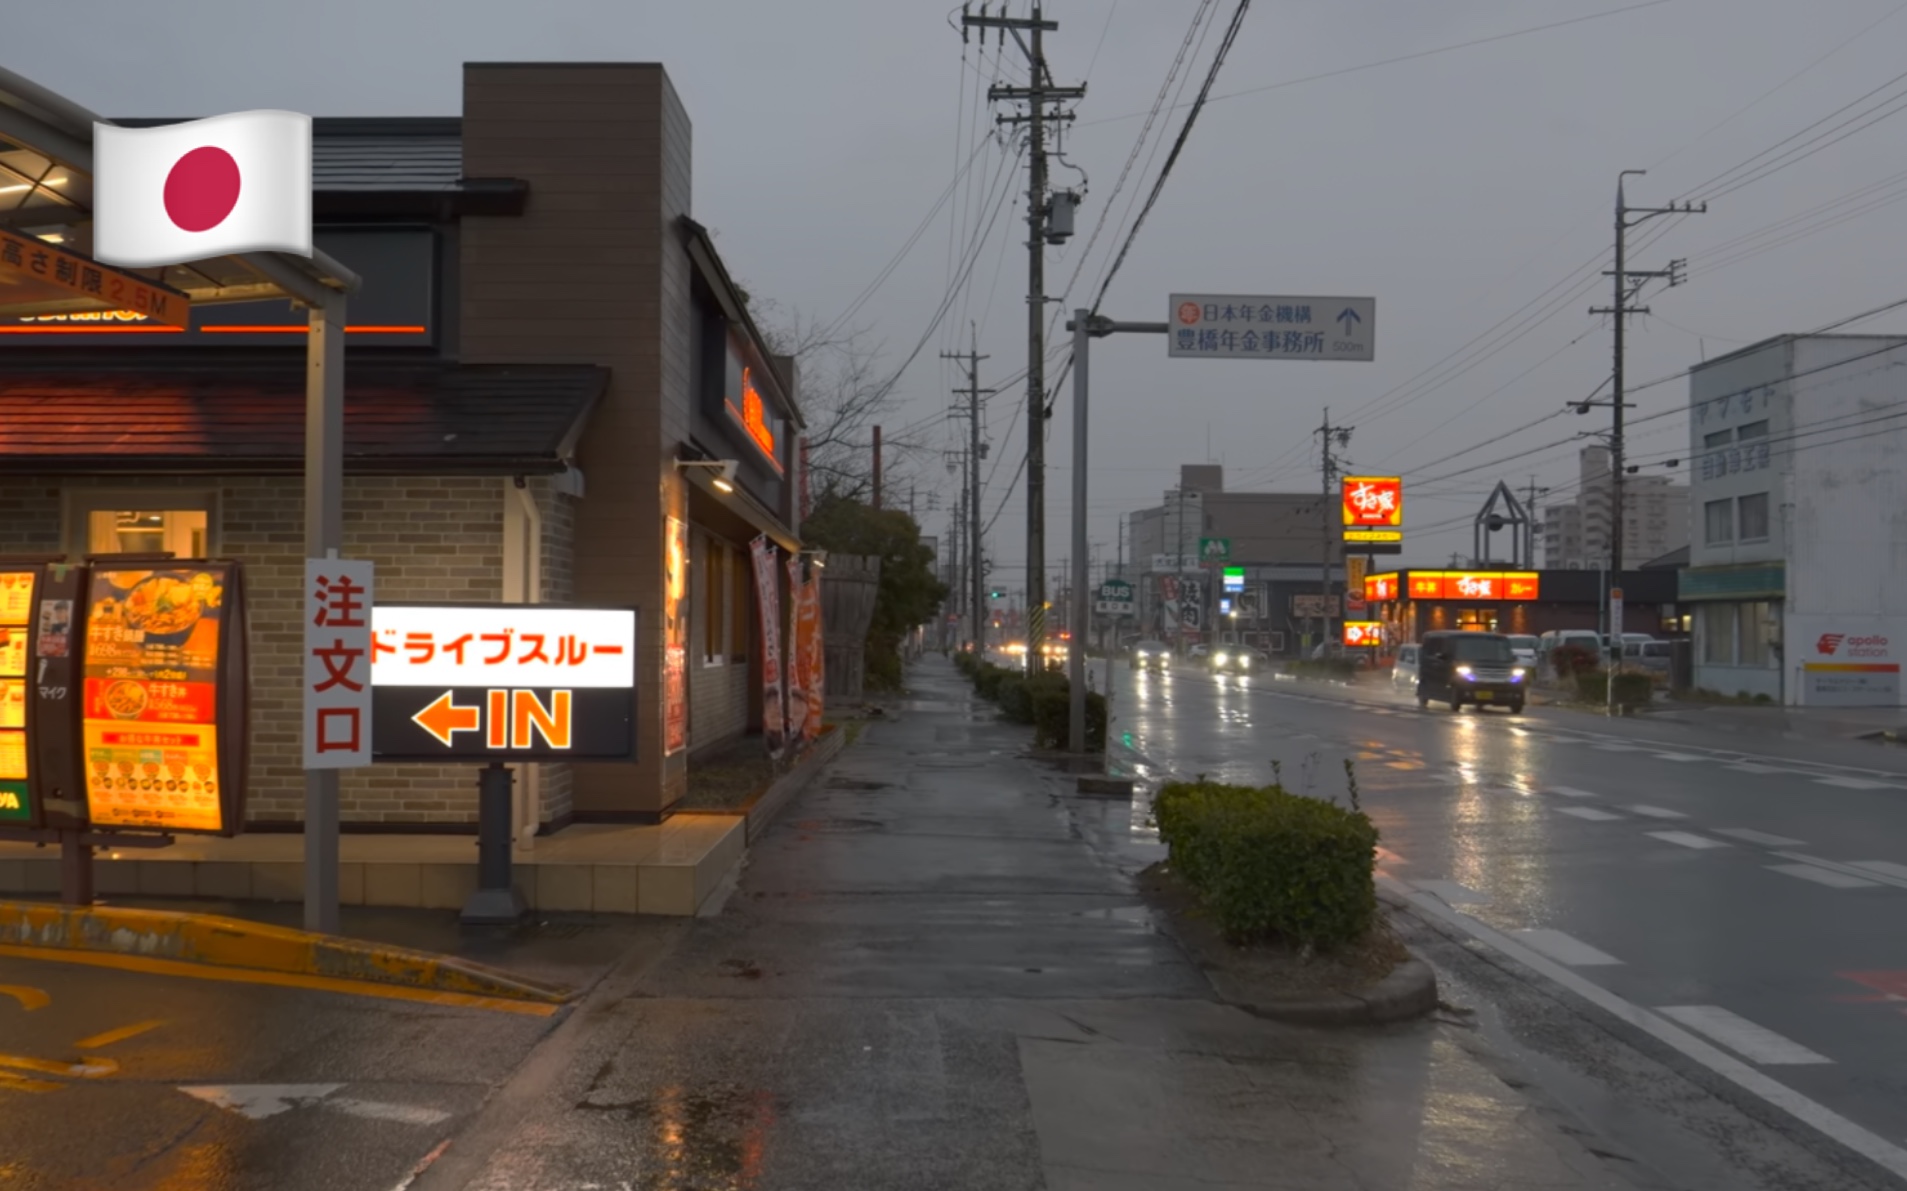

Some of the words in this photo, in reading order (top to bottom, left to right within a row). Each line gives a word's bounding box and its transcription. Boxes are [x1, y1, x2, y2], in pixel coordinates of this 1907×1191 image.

[1203, 304, 1312, 324] 日本年金機構
[1176, 329, 1325, 353] 豊橋年金事務所
[1333, 341, 1364, 352] 500m
[1350, 481, 1394, 513] すき家
[1101, 585, 1130, 598] BUS
[370, 628, 624, 666] ドライブスルー
[1847, 634, 1888, 647] apollo
[1847, 648, 1888, 657] station
[312, 574, 365, 754] 注文口
[38, 687, 68, 700] マイク
[487, 688, 573, 750] IN
